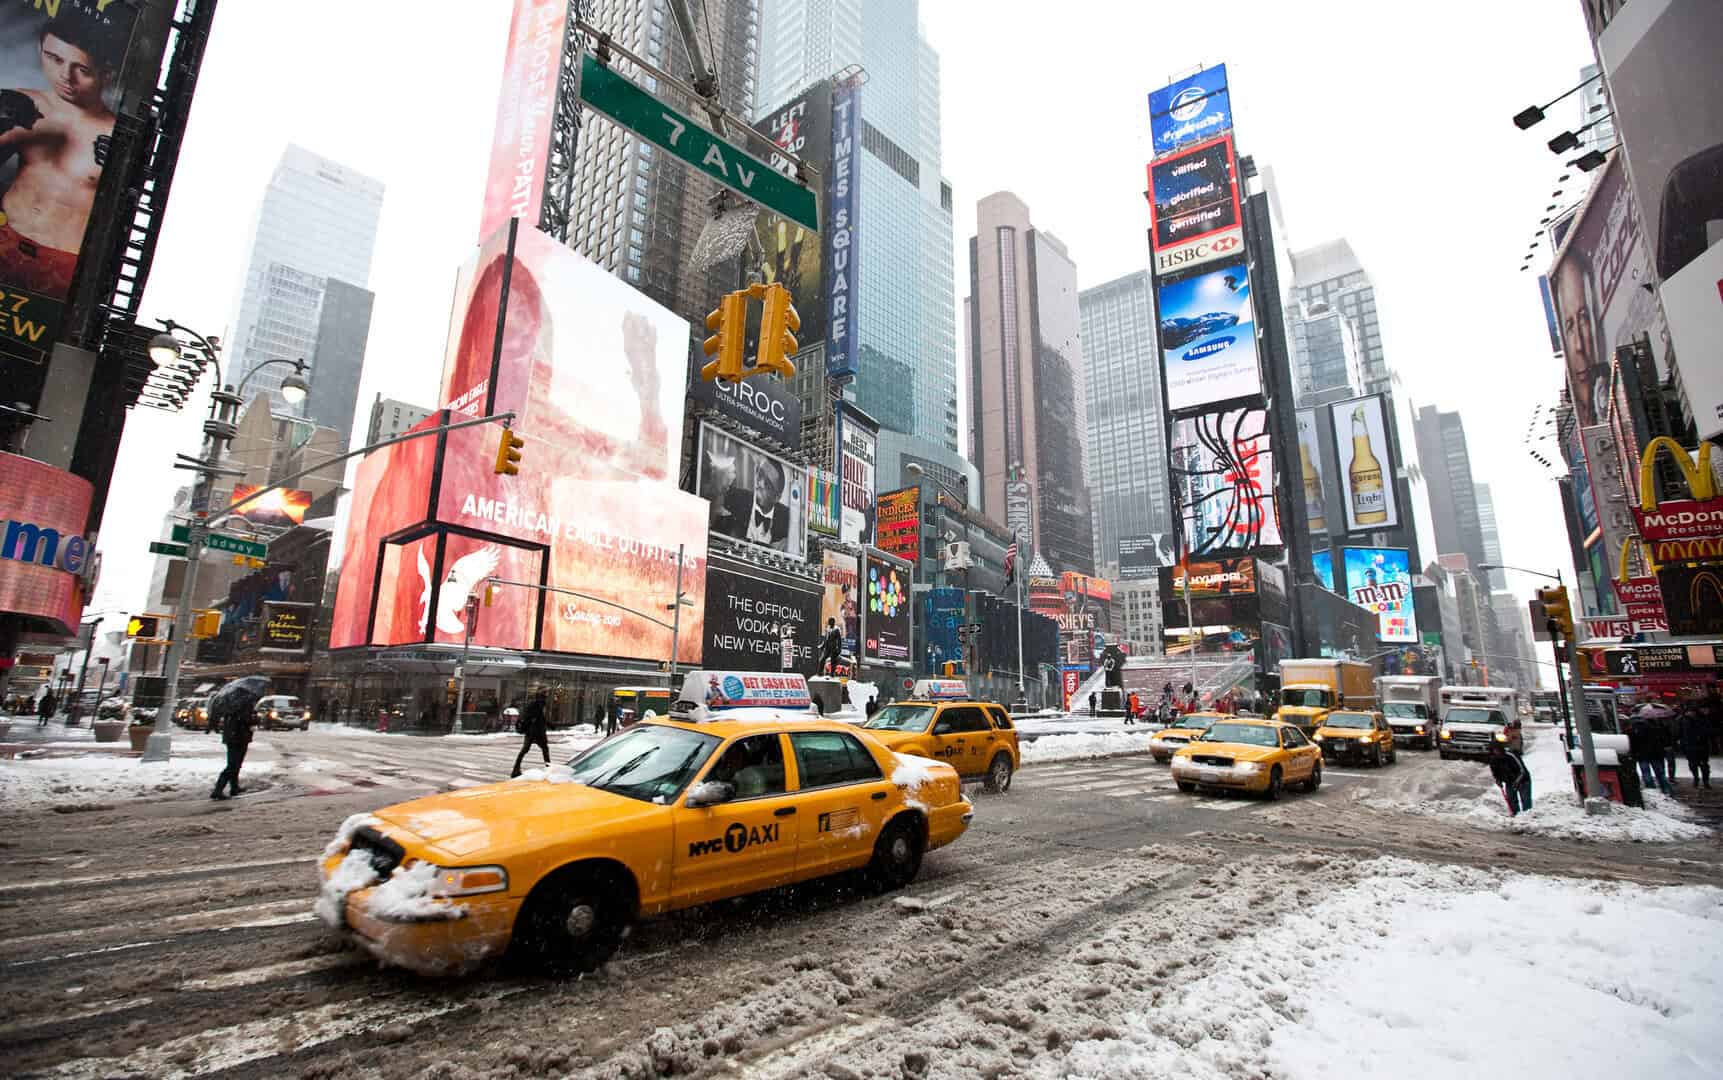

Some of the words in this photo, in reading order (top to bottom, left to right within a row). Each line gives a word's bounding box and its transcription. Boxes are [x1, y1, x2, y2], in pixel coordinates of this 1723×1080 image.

[772, 100, 807, 134] LEFT
[662, 112, 685, 146] 7
[702, 143, 755, 188] AV
[833, 99, 852, 198] TIMES
[1171, 157, 1207, 177] vilified
[511, 158, 535, 218] PATH
[1169, 207, 1221, 233] gentrified
[1159, 243, 1209, 269] HSBC
[832, 208, 851, 343] SQUARE
[1189, 341, 1231, 356] SAMSUNG
[844, 455, 865, 489] BILLY
[462, 493, 560, 538] AMERICAN
[565, 524, 613, 550] EAGLE
[728, 594, 753, 613] THE
[755, 601, 805, 622] OFFICIAL
[713, 633, 745, 651] NEW
[748, 638, 782, 656] YEAR
[792, 644, 812, 659] EVE
[742, 676, 759, 689] GET
[762, 677, 785, 689] CASH
[787, 678, 806, 690] FAST
[688, 837, 723, 857] NYC
[724, 822, 779, 852] TAXI
